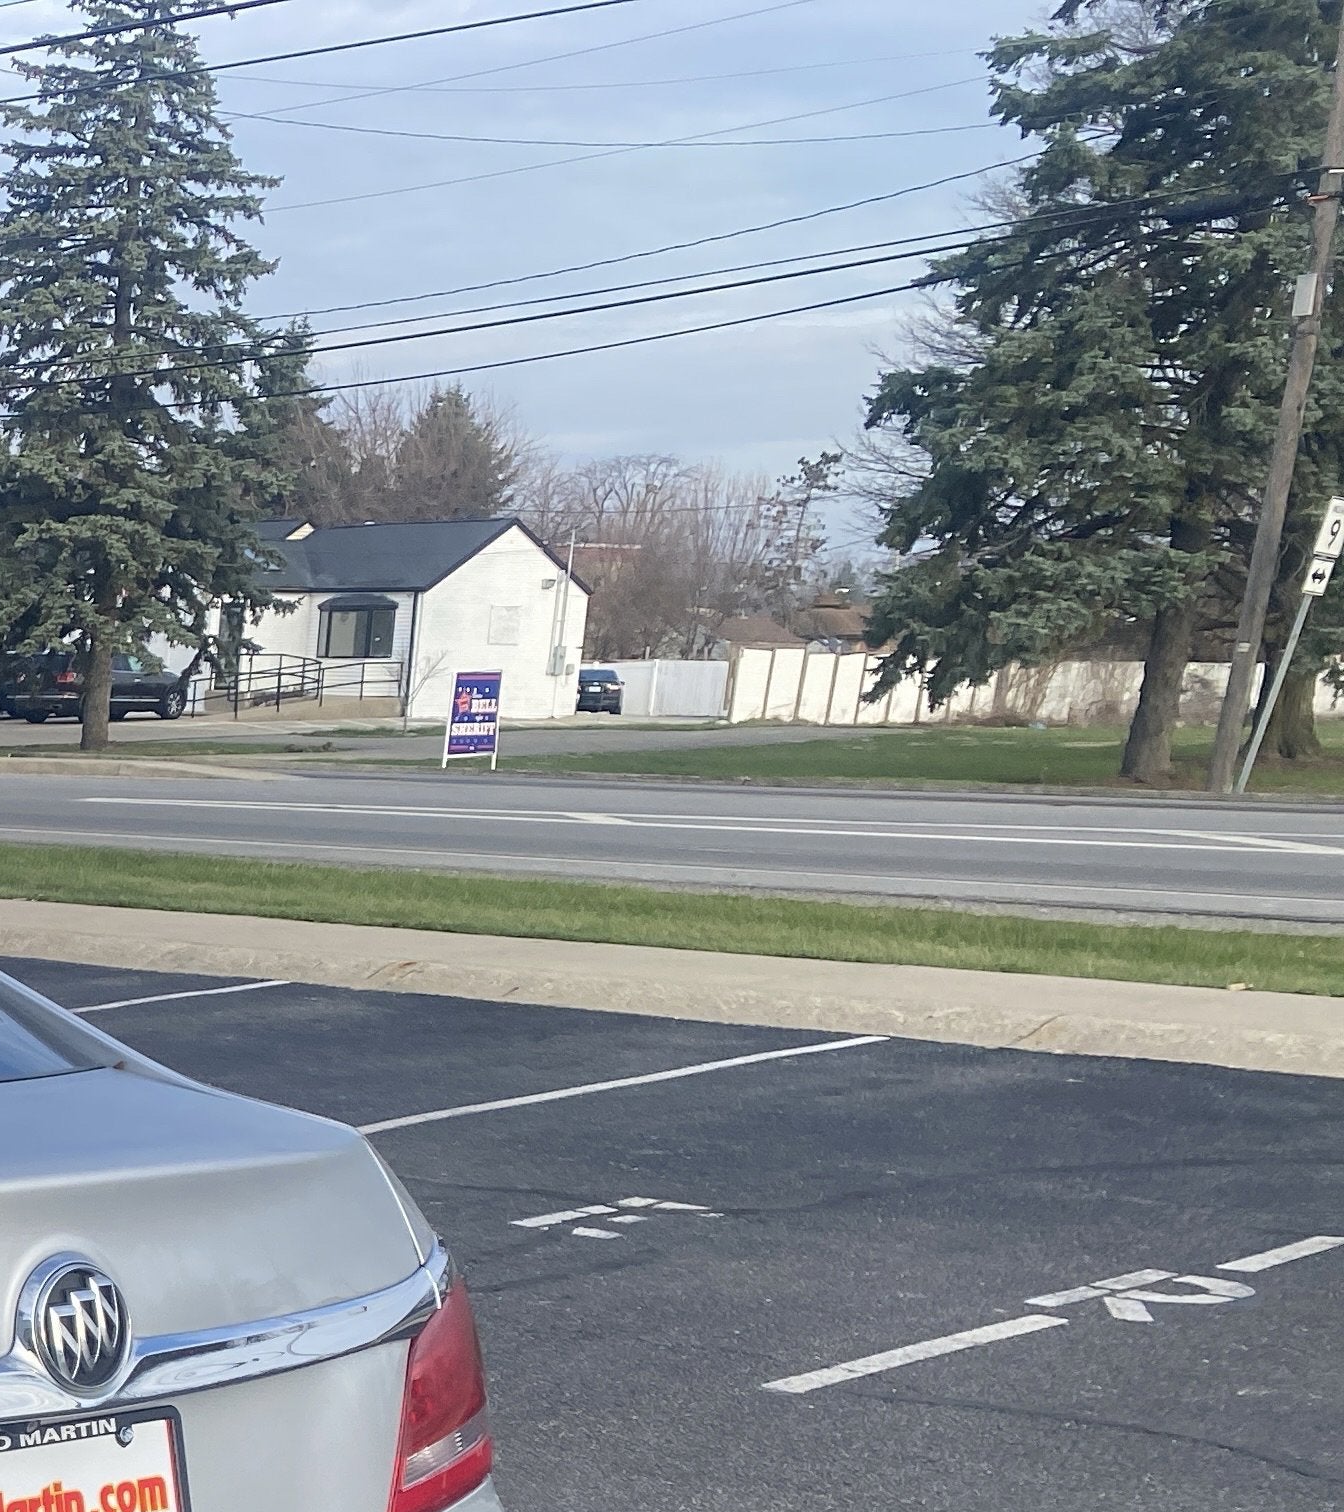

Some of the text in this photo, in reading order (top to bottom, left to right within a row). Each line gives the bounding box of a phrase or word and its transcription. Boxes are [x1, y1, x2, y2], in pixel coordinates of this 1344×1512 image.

[1327, 519, 1341, 550] 9
[471, 698, 498, 713] BELL
[450, 722, 496, 736] SHERIFF
[19, 1417, 118, 1447] MARTIN
